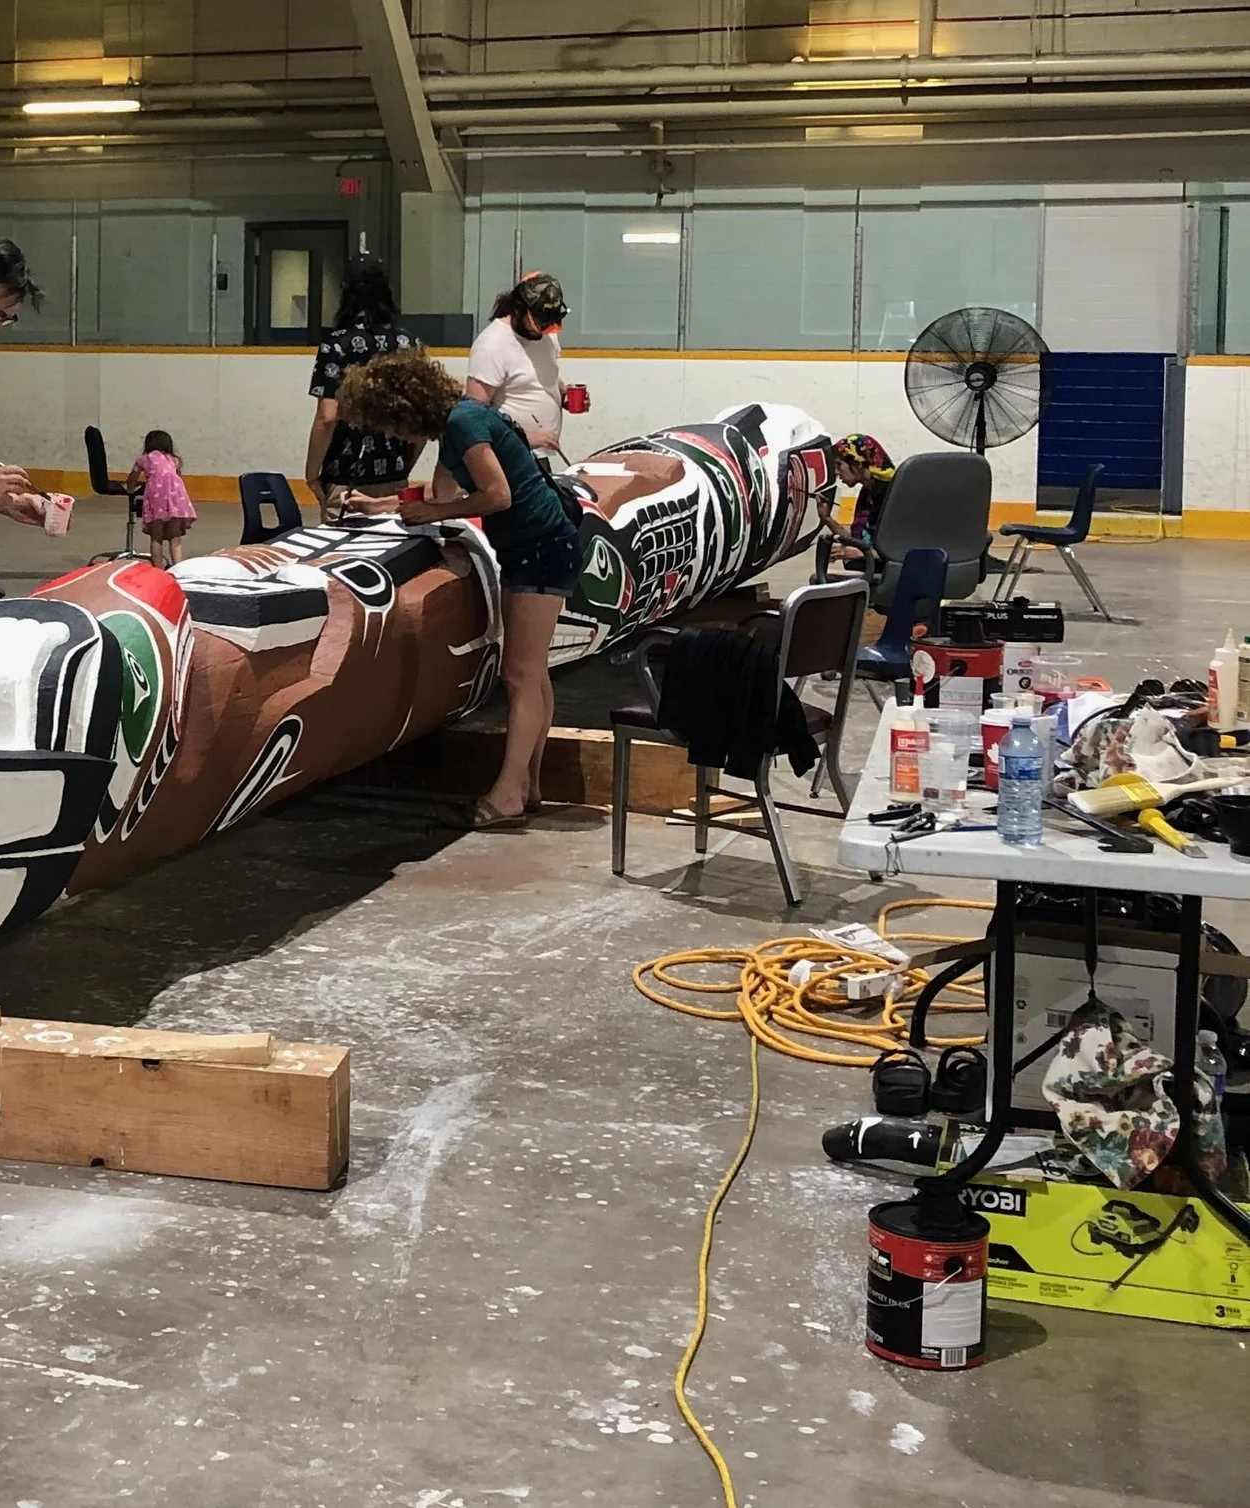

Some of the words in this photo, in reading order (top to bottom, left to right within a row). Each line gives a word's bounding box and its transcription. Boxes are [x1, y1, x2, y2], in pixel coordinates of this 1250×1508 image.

[985, 612, 1008, 620] PLUS
[958, 1187, 1021, 1212] RYOBI
[1215, 1305, 1225, 1317] 3
